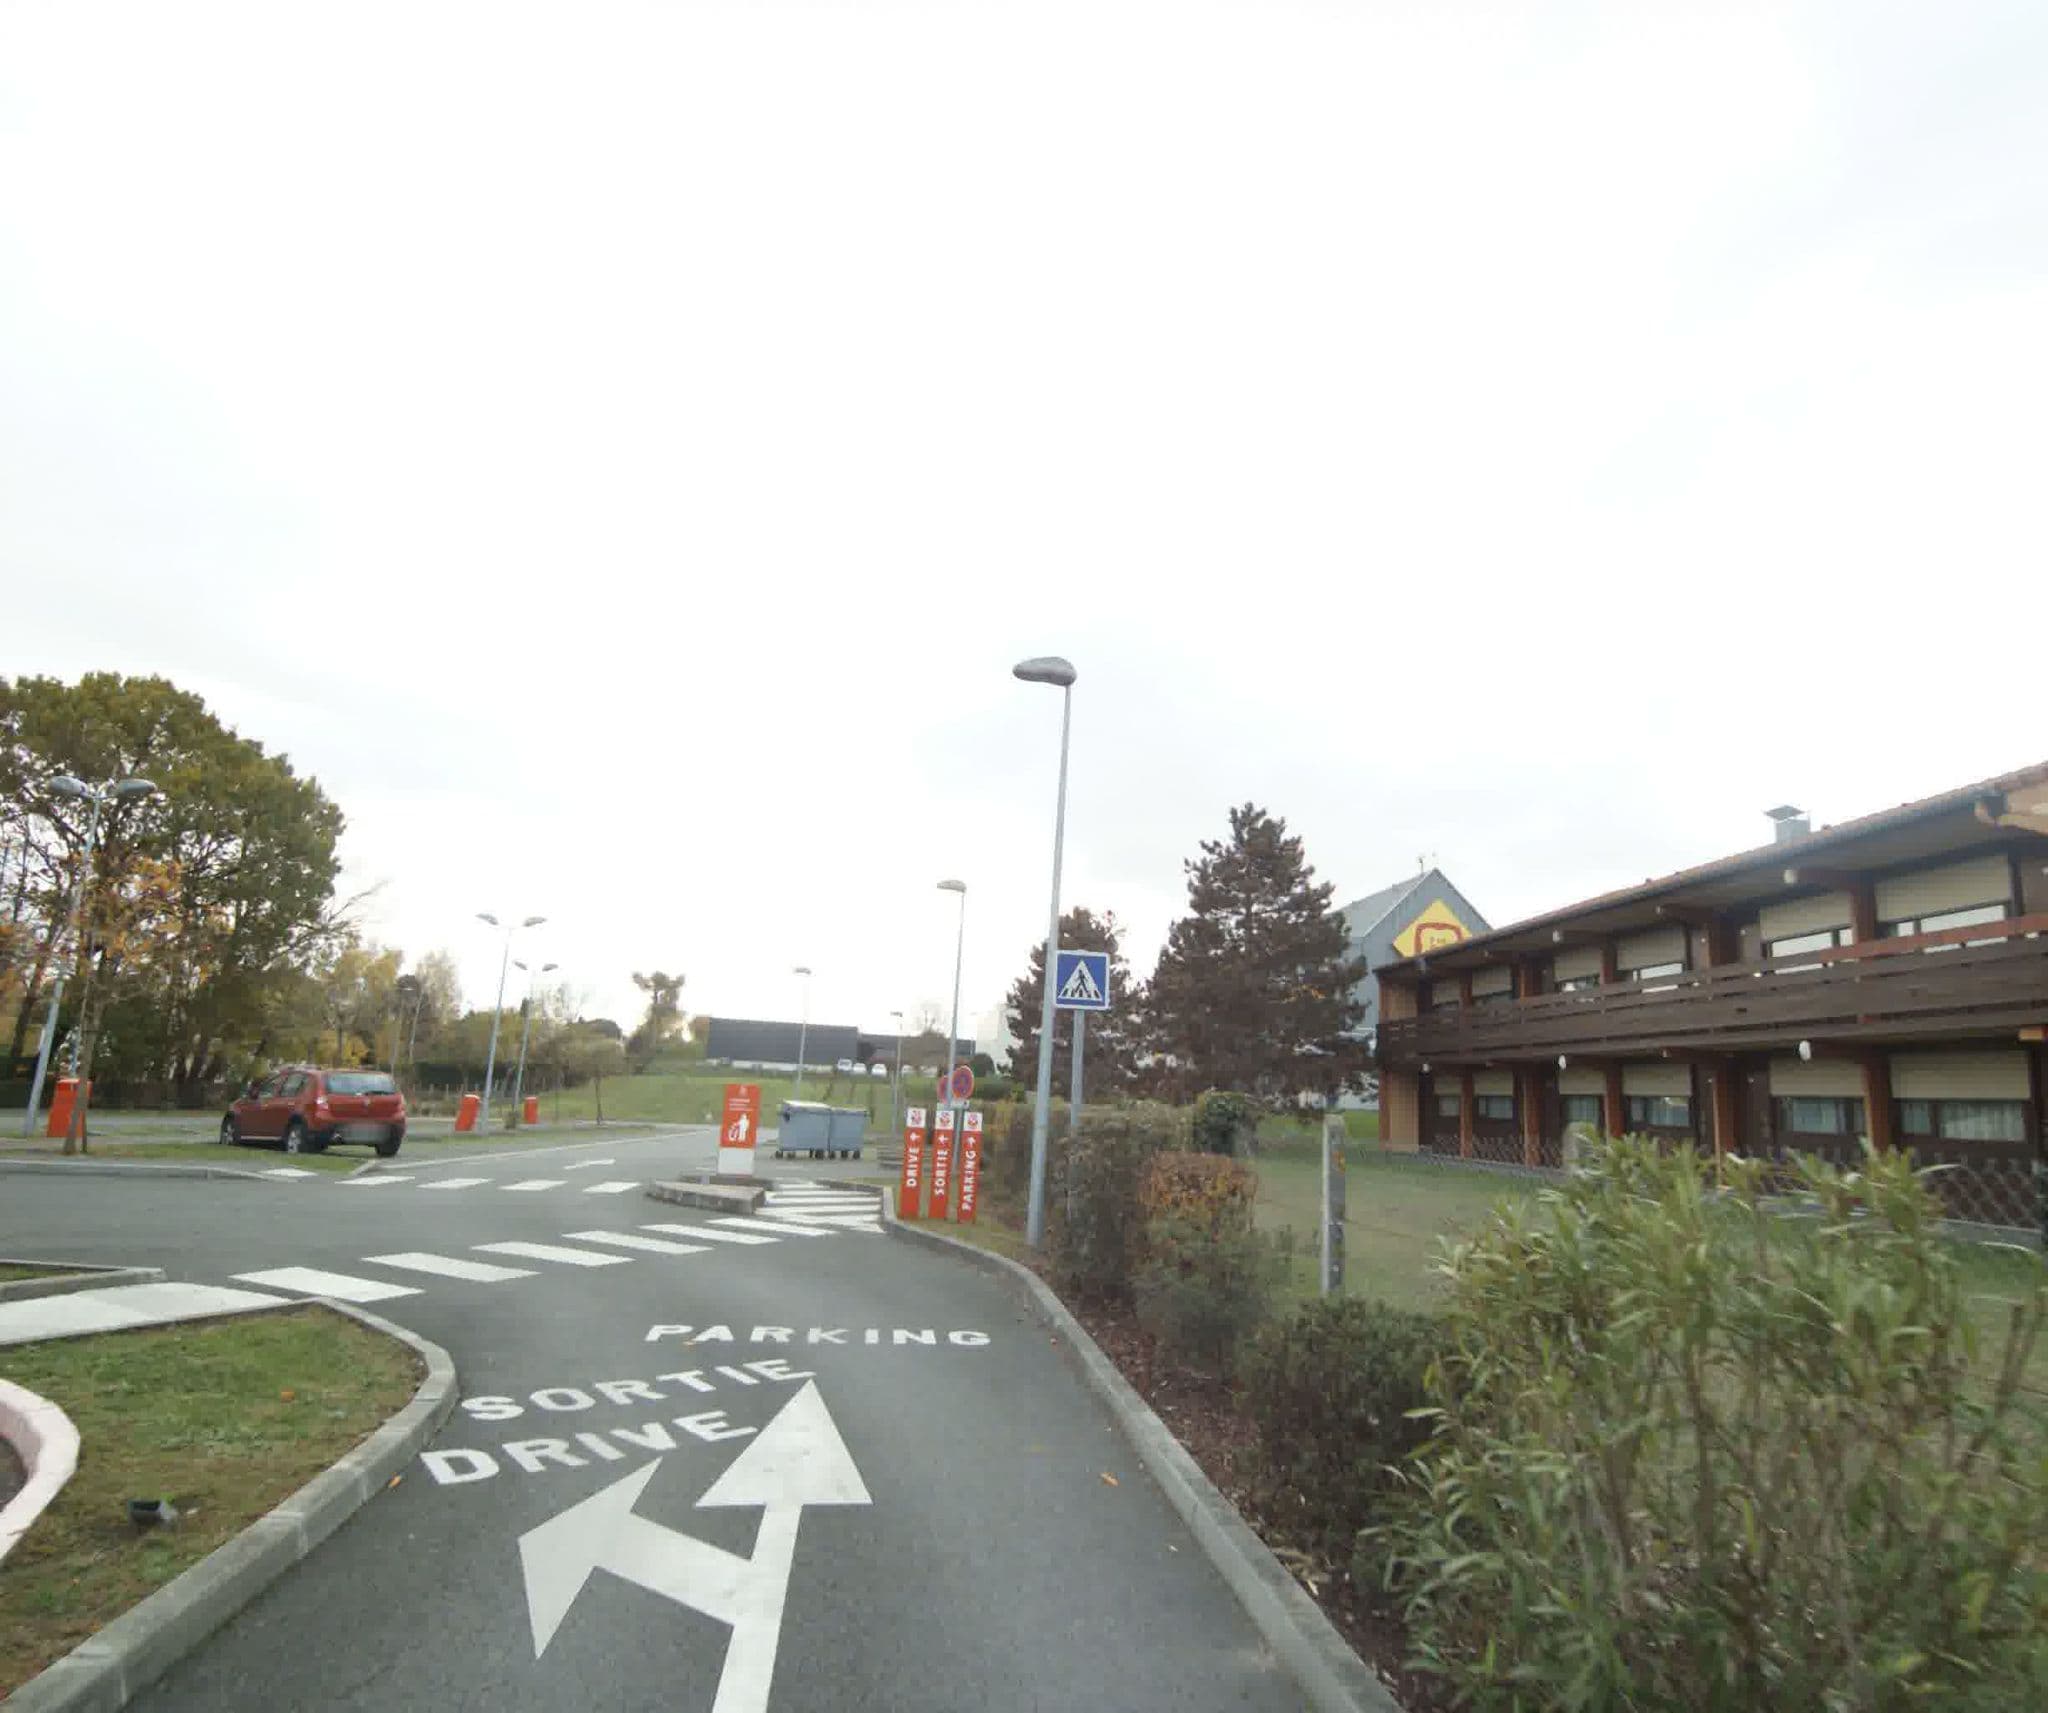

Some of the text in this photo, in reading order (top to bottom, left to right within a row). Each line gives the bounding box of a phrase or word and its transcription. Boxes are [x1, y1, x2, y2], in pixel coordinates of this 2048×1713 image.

[906, 1147, 920, 1187] DRIVE
[935, 1149, 948, 1196] SORTIE
[962, 1150, 976, 1211] PARKING
[645, 1324, 992, 1346] PARKING
[460, 1358, 817, 1420] SORTIE
[420, 1409, 758, 1485] DRIVE
